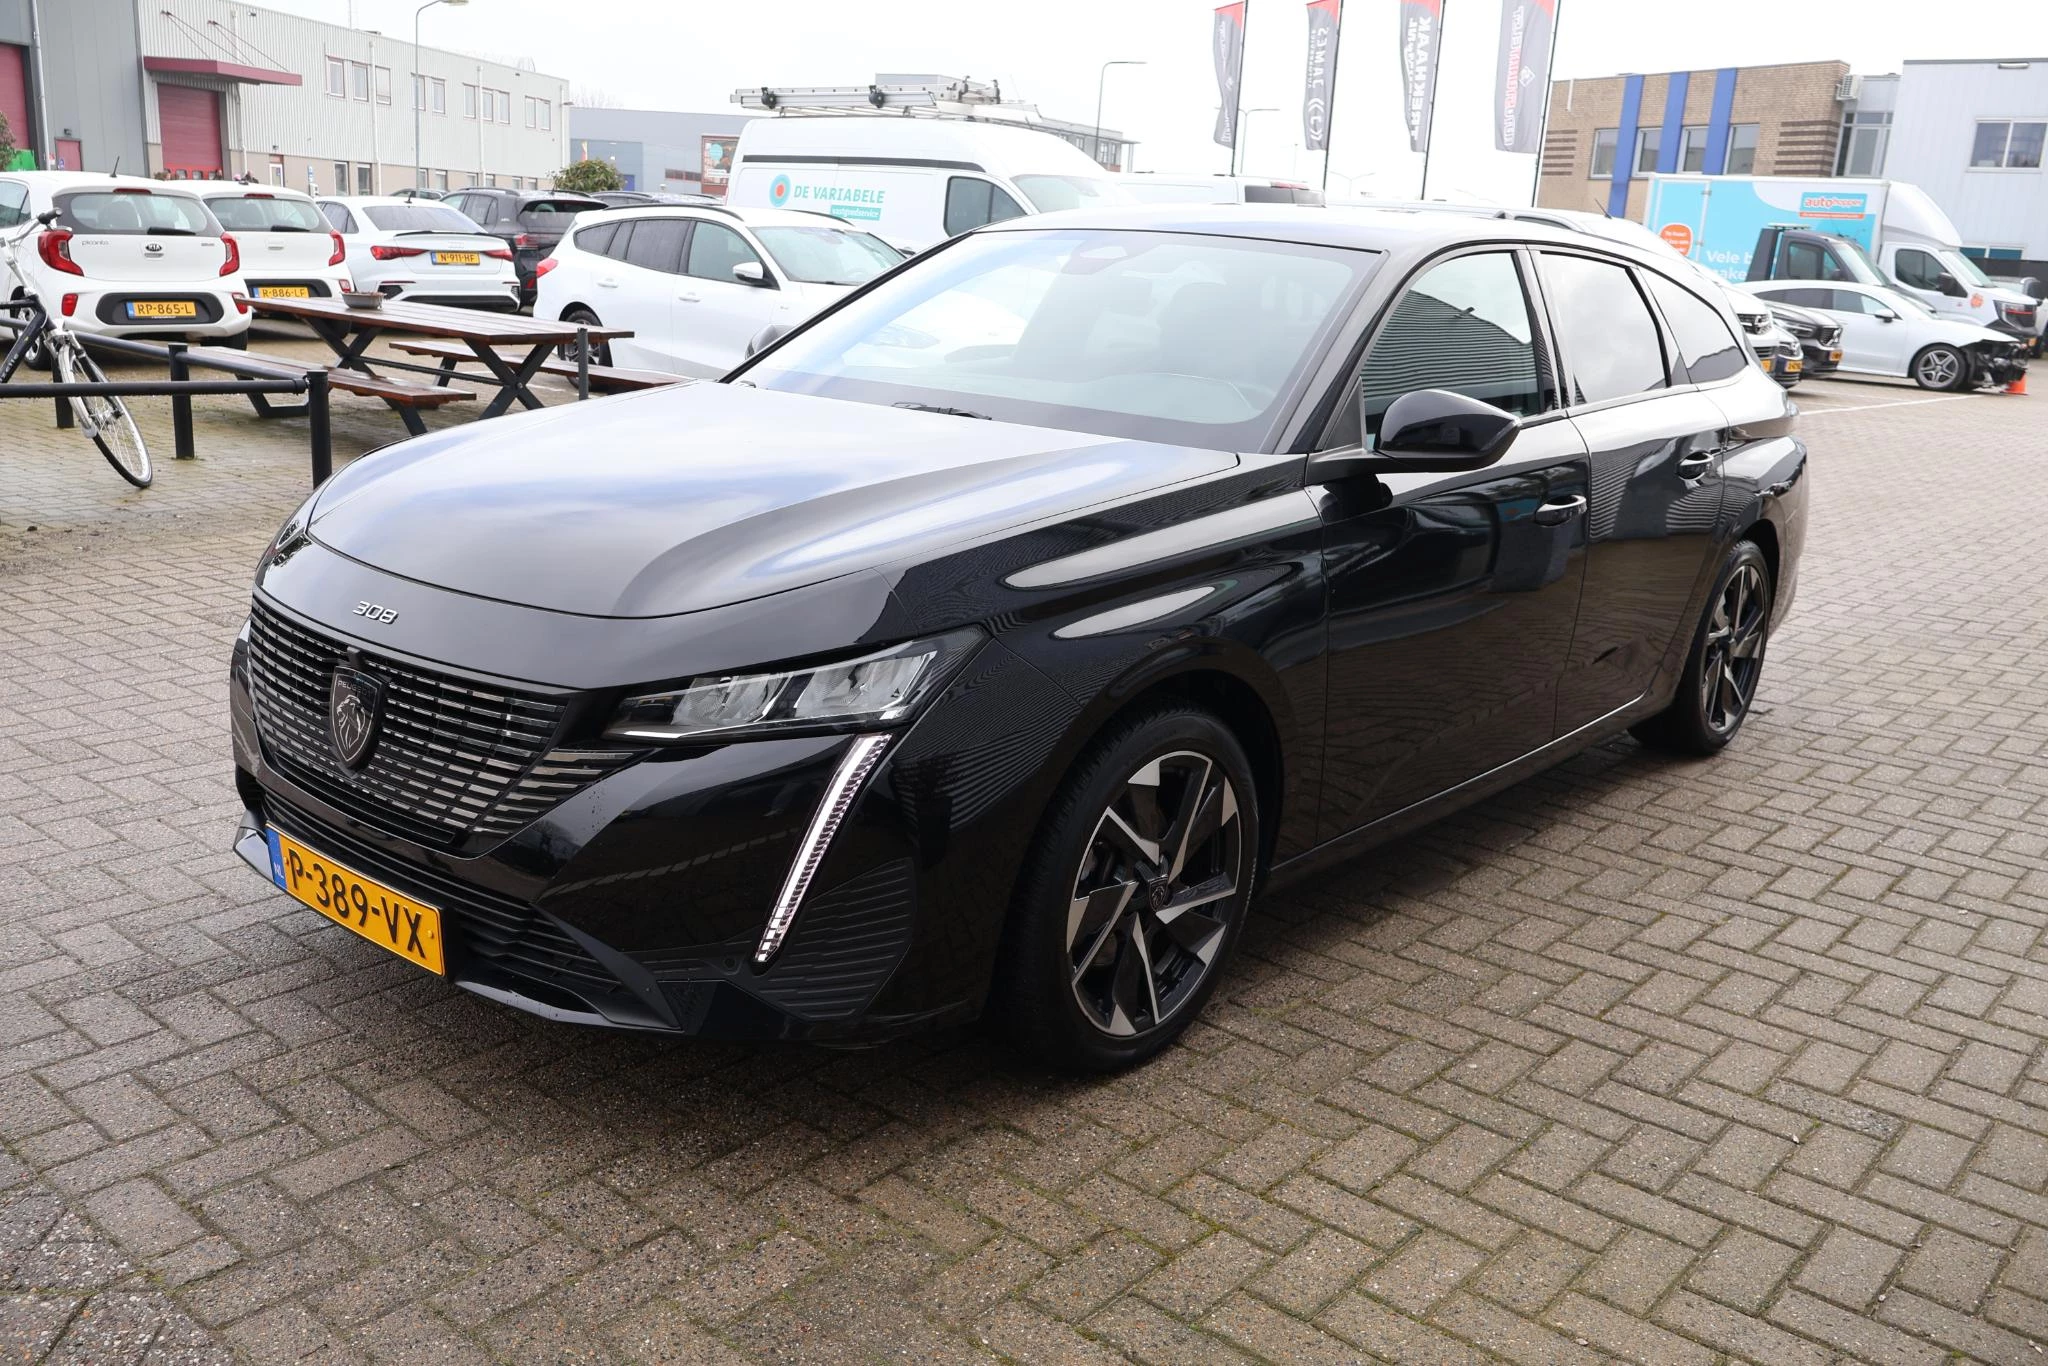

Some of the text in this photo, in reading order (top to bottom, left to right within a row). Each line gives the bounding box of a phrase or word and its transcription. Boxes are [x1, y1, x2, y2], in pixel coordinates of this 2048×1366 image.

[794, 185, 885, 204] DE VARIABELE
[1706, 249, 1740, 264] Vele
[262, 288, 306, 297] R-886-LF
[137, 303, 192, 314] RP-865-L
[352, 600, 398, 625] 308
[273, 847, 427, 960] NL P-389-VX
